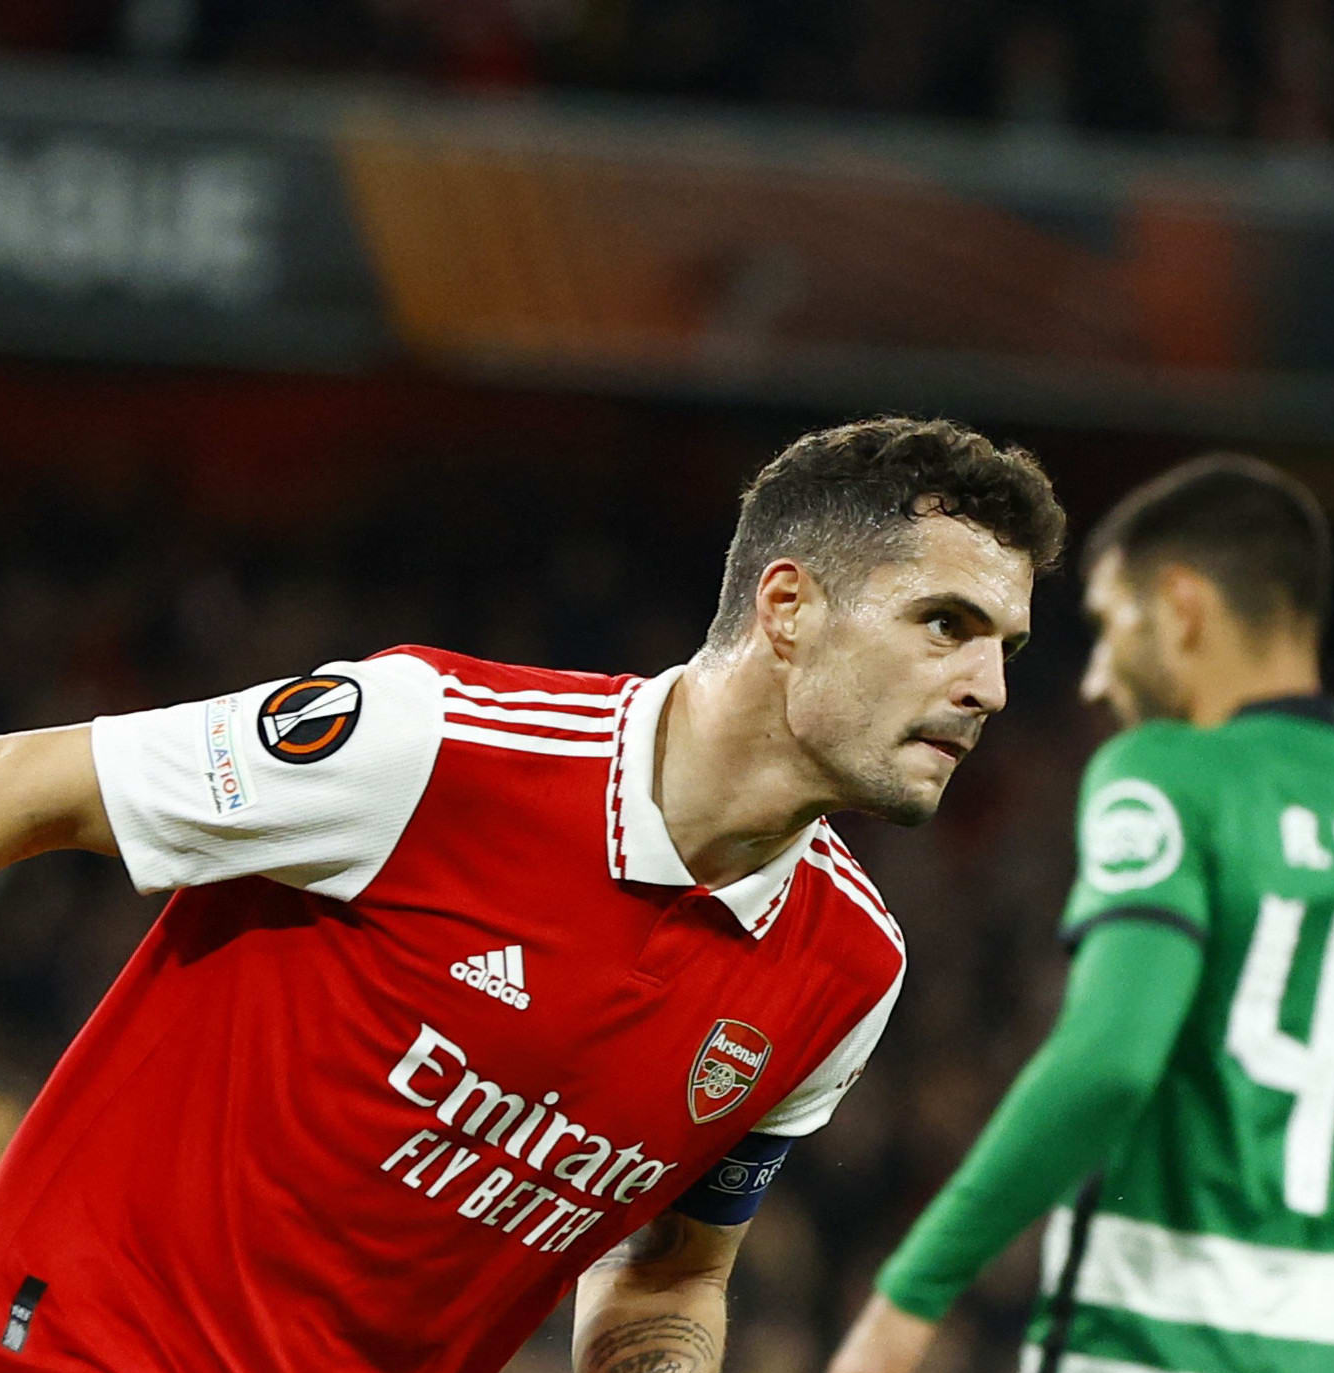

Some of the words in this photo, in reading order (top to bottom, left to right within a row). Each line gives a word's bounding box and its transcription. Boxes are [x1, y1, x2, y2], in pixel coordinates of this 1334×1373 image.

[449, 961, 532, 1011] adidas
[710, 1033, 764, 1068] Arsenal
[379, 1128, 481, 1200] FLY
[456, 1165, 606, 1254] BETTER
